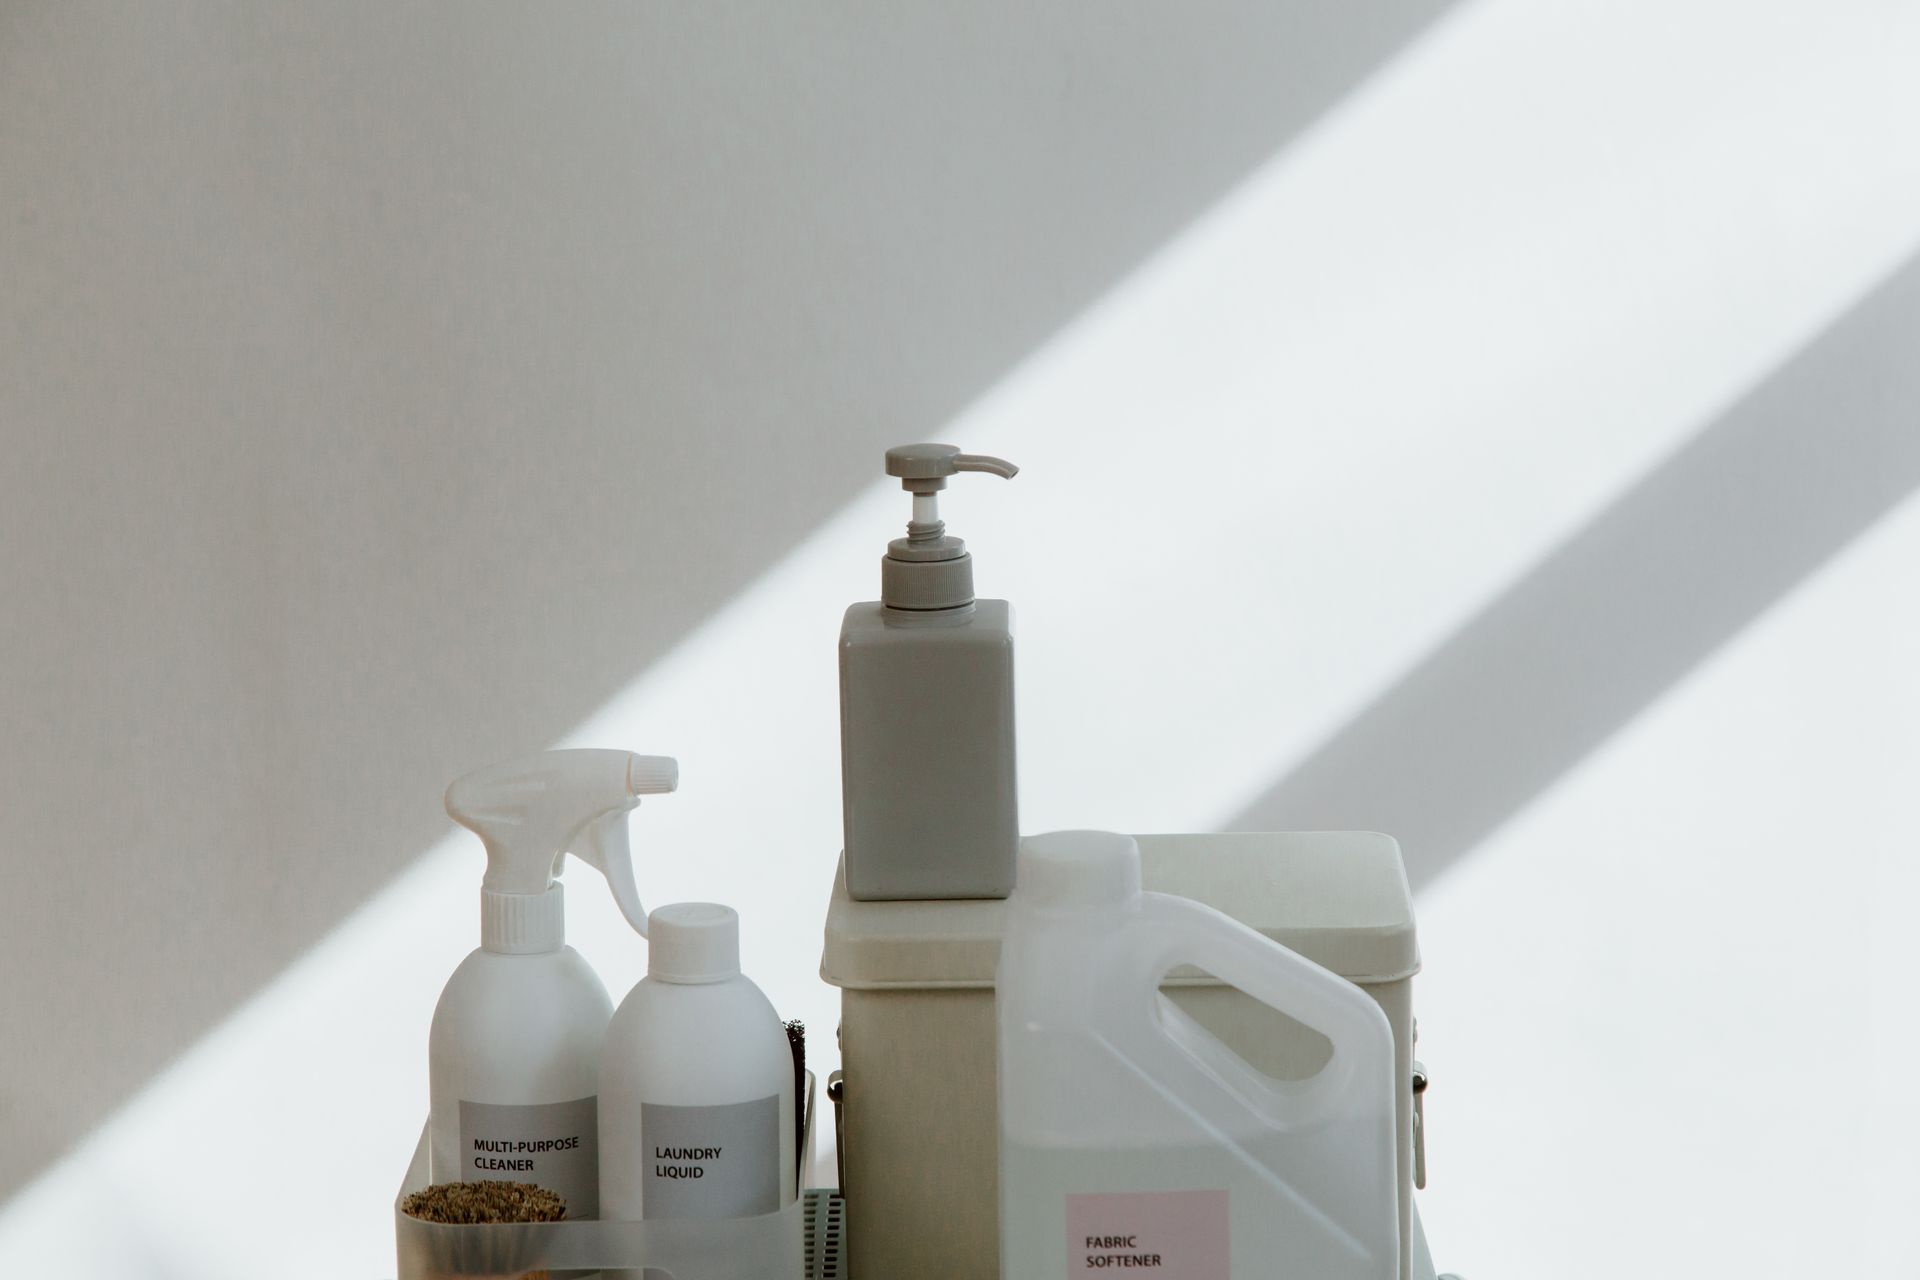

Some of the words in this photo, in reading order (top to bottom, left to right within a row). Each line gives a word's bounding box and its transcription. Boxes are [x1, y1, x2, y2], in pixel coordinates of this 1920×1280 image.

[473, 1136, 579, 1153] MULTI-PURPOSE
[655, 1146, 722, 1160] LAUNDRY
[473, 1157, 535, 1172] CLEANER
[655, 1164, 704, 1180] LIQUID
[1085, 1235, 1137, 1249] FABRIC
[1086, 1254, 1162, 1268] SOFTENER
